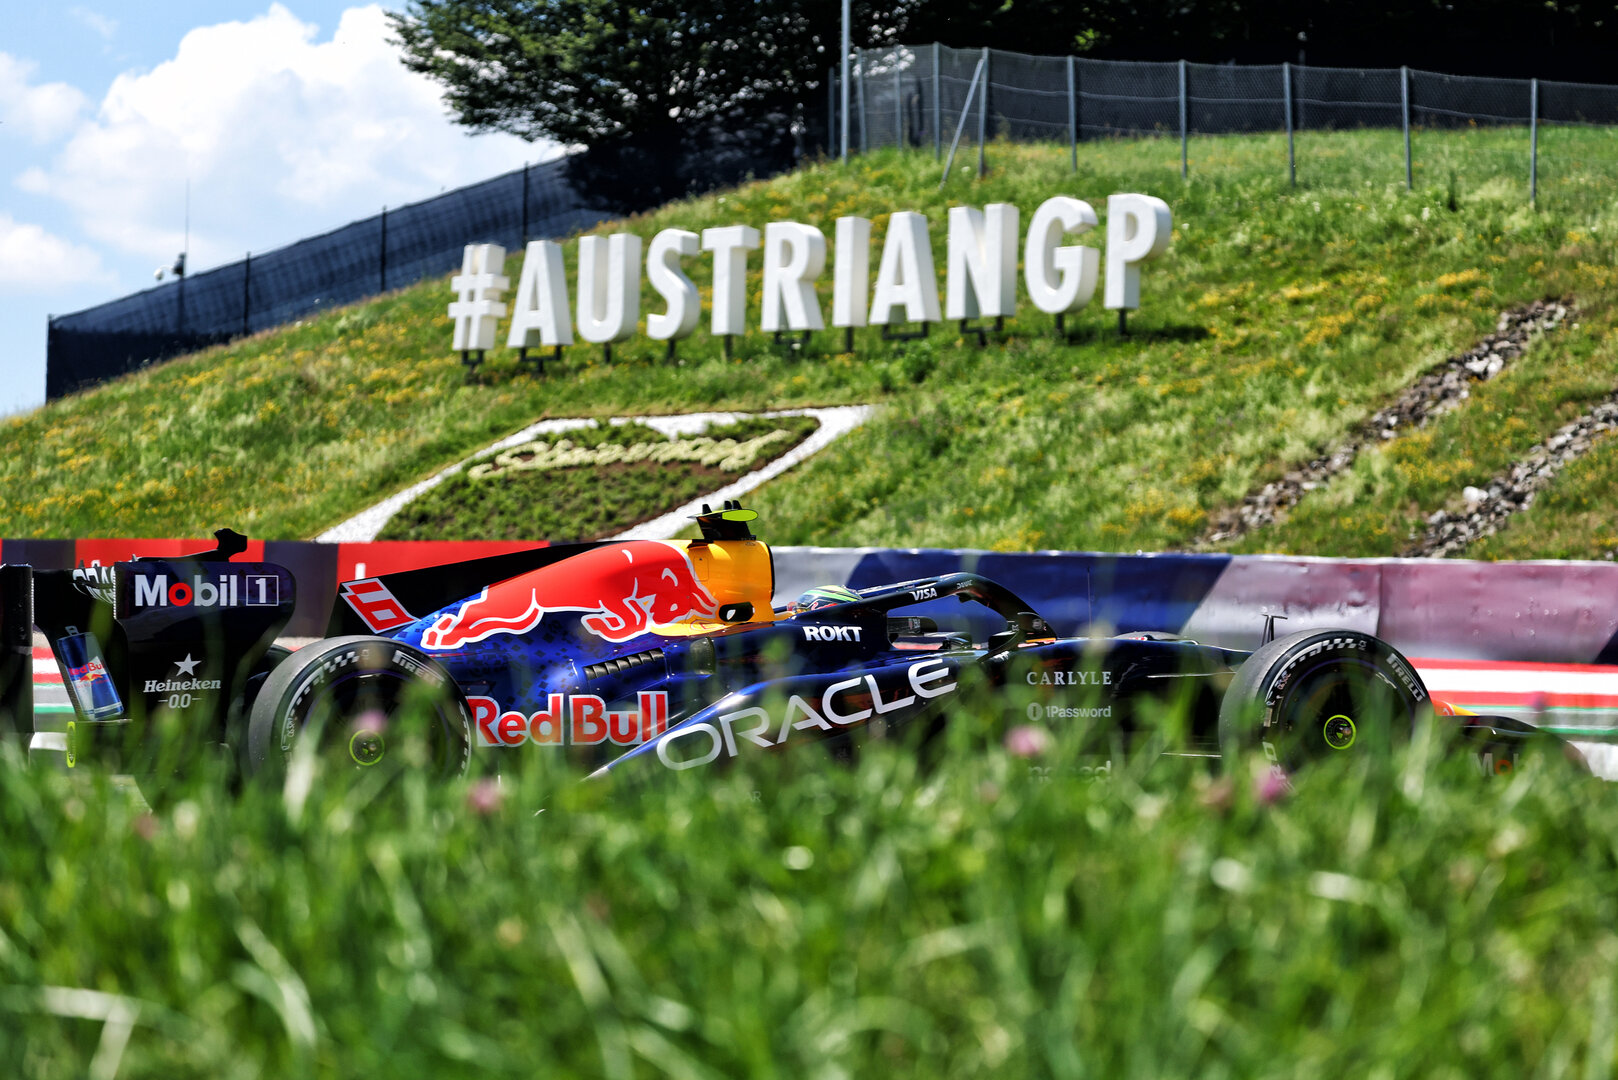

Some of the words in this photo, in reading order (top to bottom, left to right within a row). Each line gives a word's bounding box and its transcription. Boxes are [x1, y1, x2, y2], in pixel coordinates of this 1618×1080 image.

[448, 193, 1172, 351] #AUSTRIANGP
[135, 574, 237, 607] Mobil
[340, 577, 421, 635] 6
[909, 588, 938, 602] VISA
[803, 626, 862, 642] ROKT
[143, 678, 222, 693] Heineken
[1026, 671, 1112, 685] CARLYLE
[1386, 653, 1426, 702] PIRELLI
[466, 693, 564, 747] Red
[569, 691, 668, 746] Bull
[656, 658, 958, 771] ORACLE
[1046, 705, 1111, 718] 1Password
